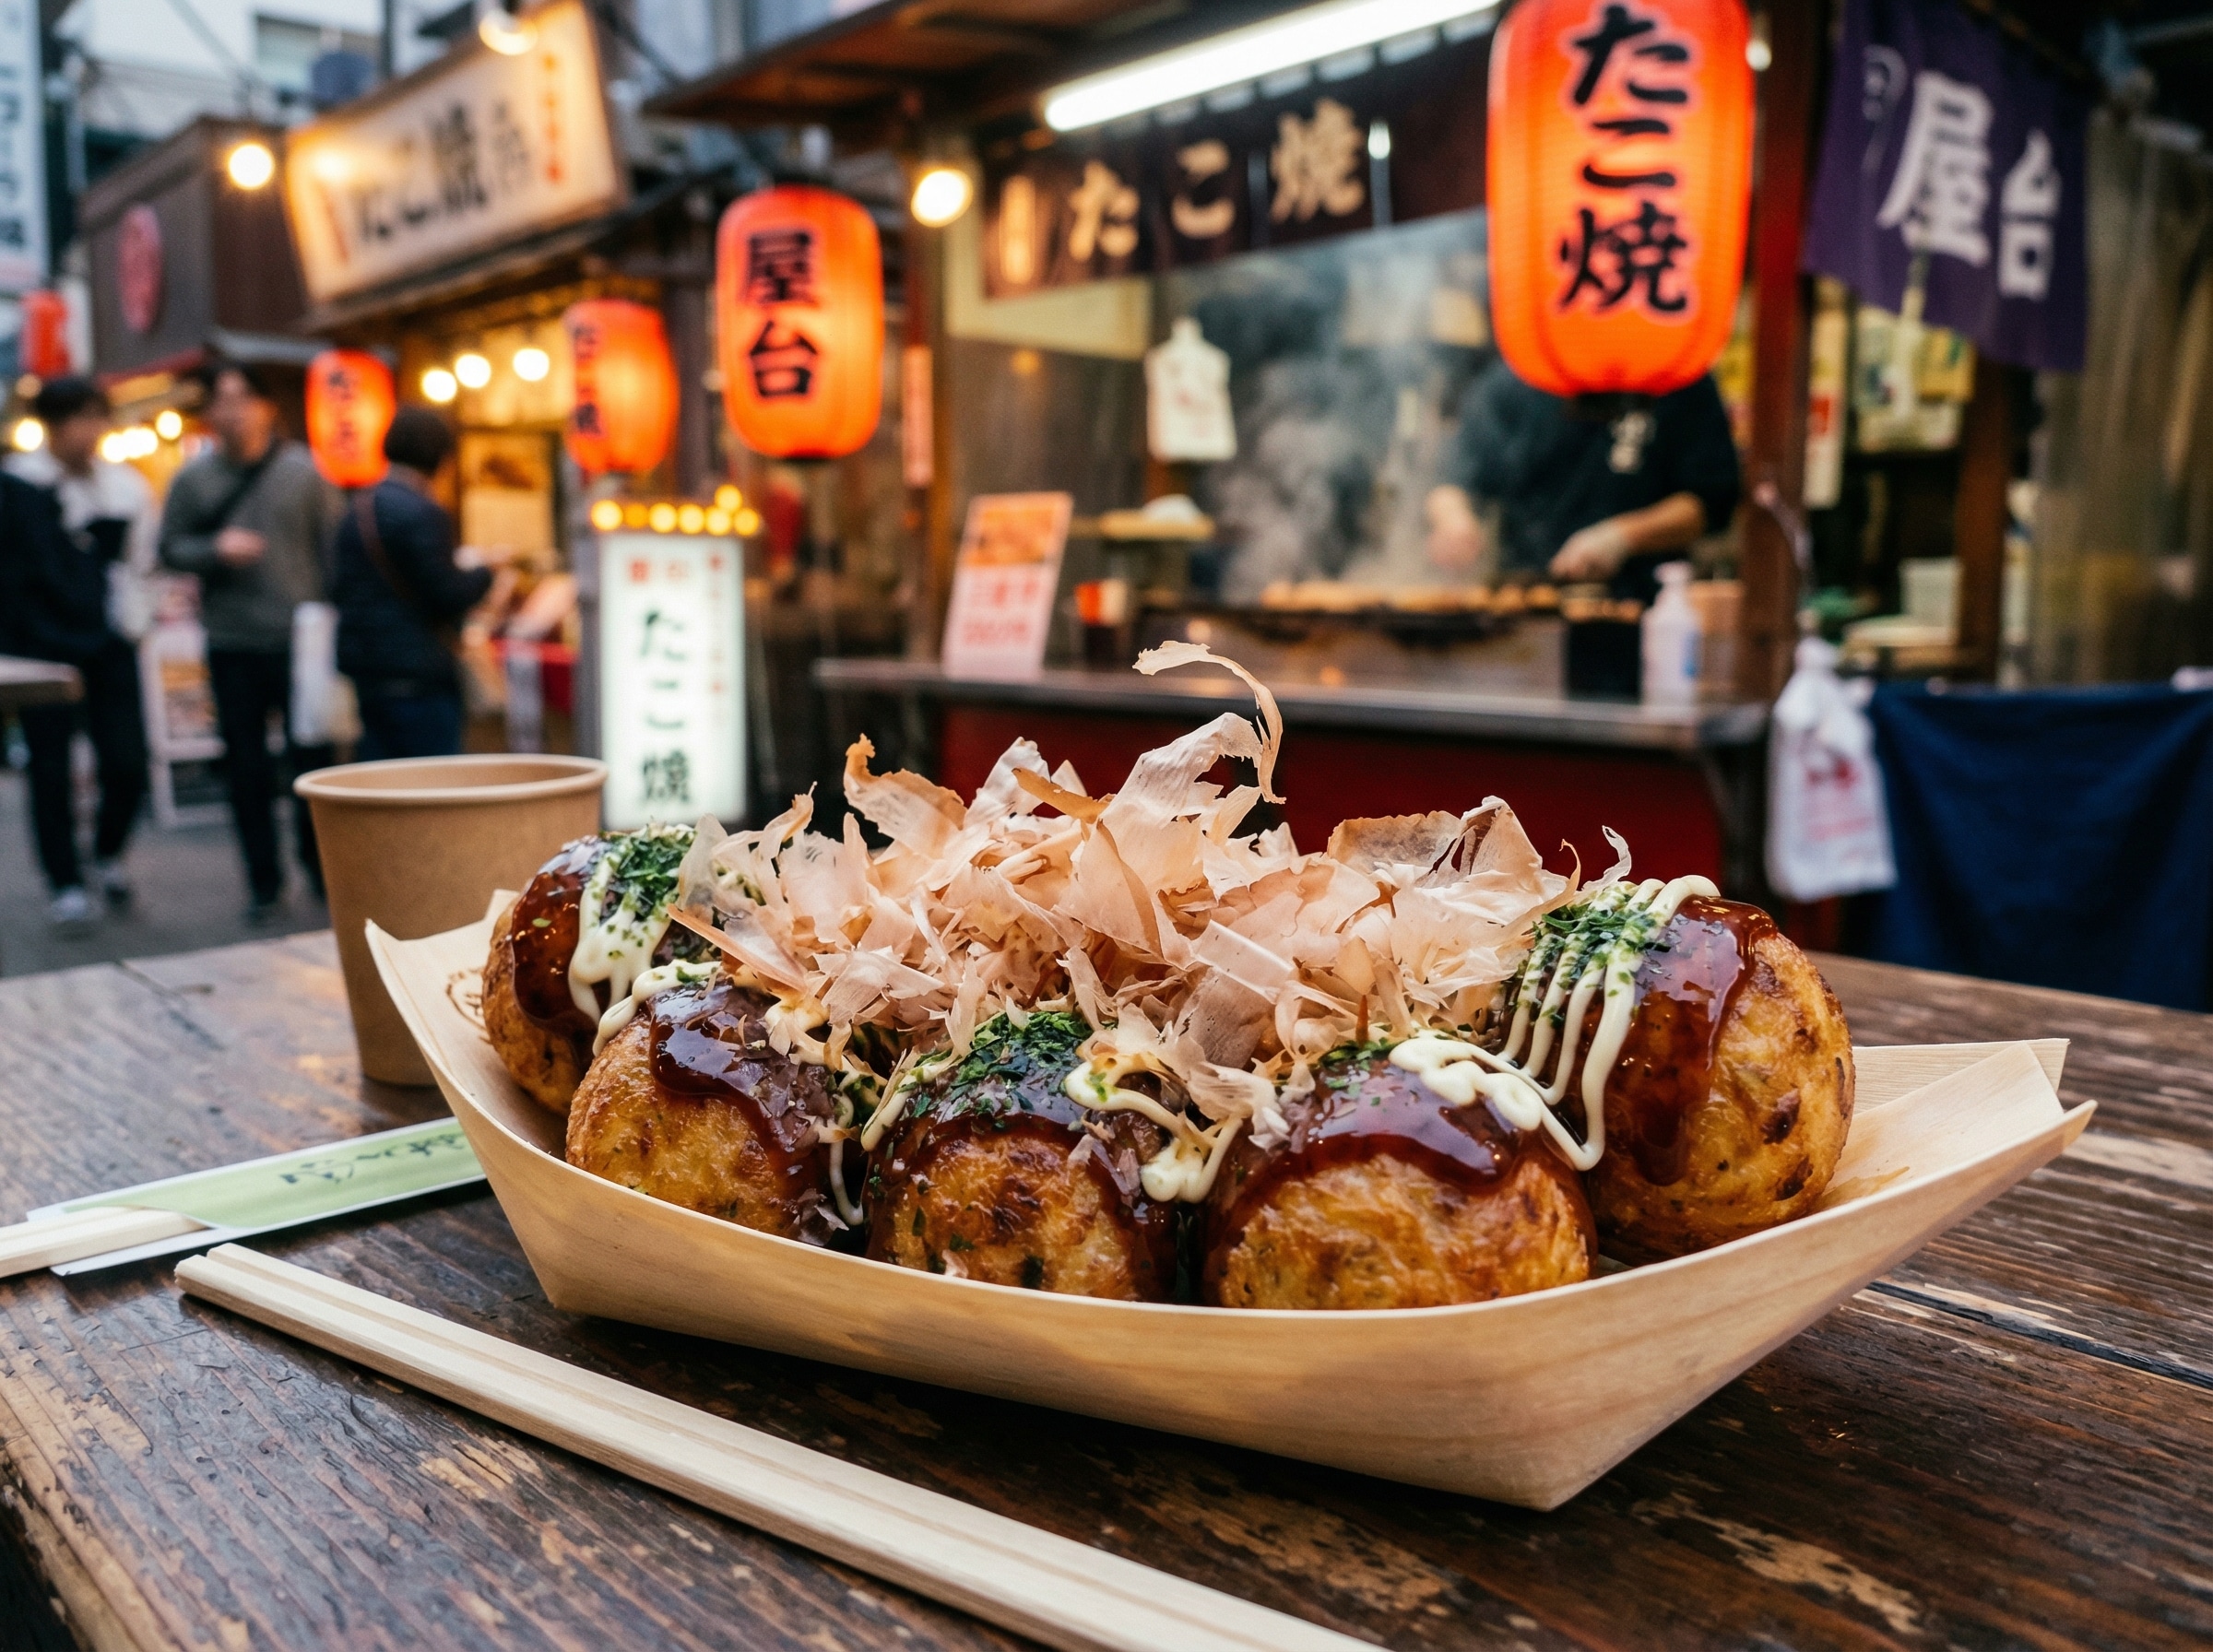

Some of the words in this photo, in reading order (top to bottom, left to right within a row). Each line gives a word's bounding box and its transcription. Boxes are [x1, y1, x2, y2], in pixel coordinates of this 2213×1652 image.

[1559, 5, 1689, 313] たこ焼
[1876, 68, 2063, 301] 屋台
[745, 230, 820, 398] 屋台
